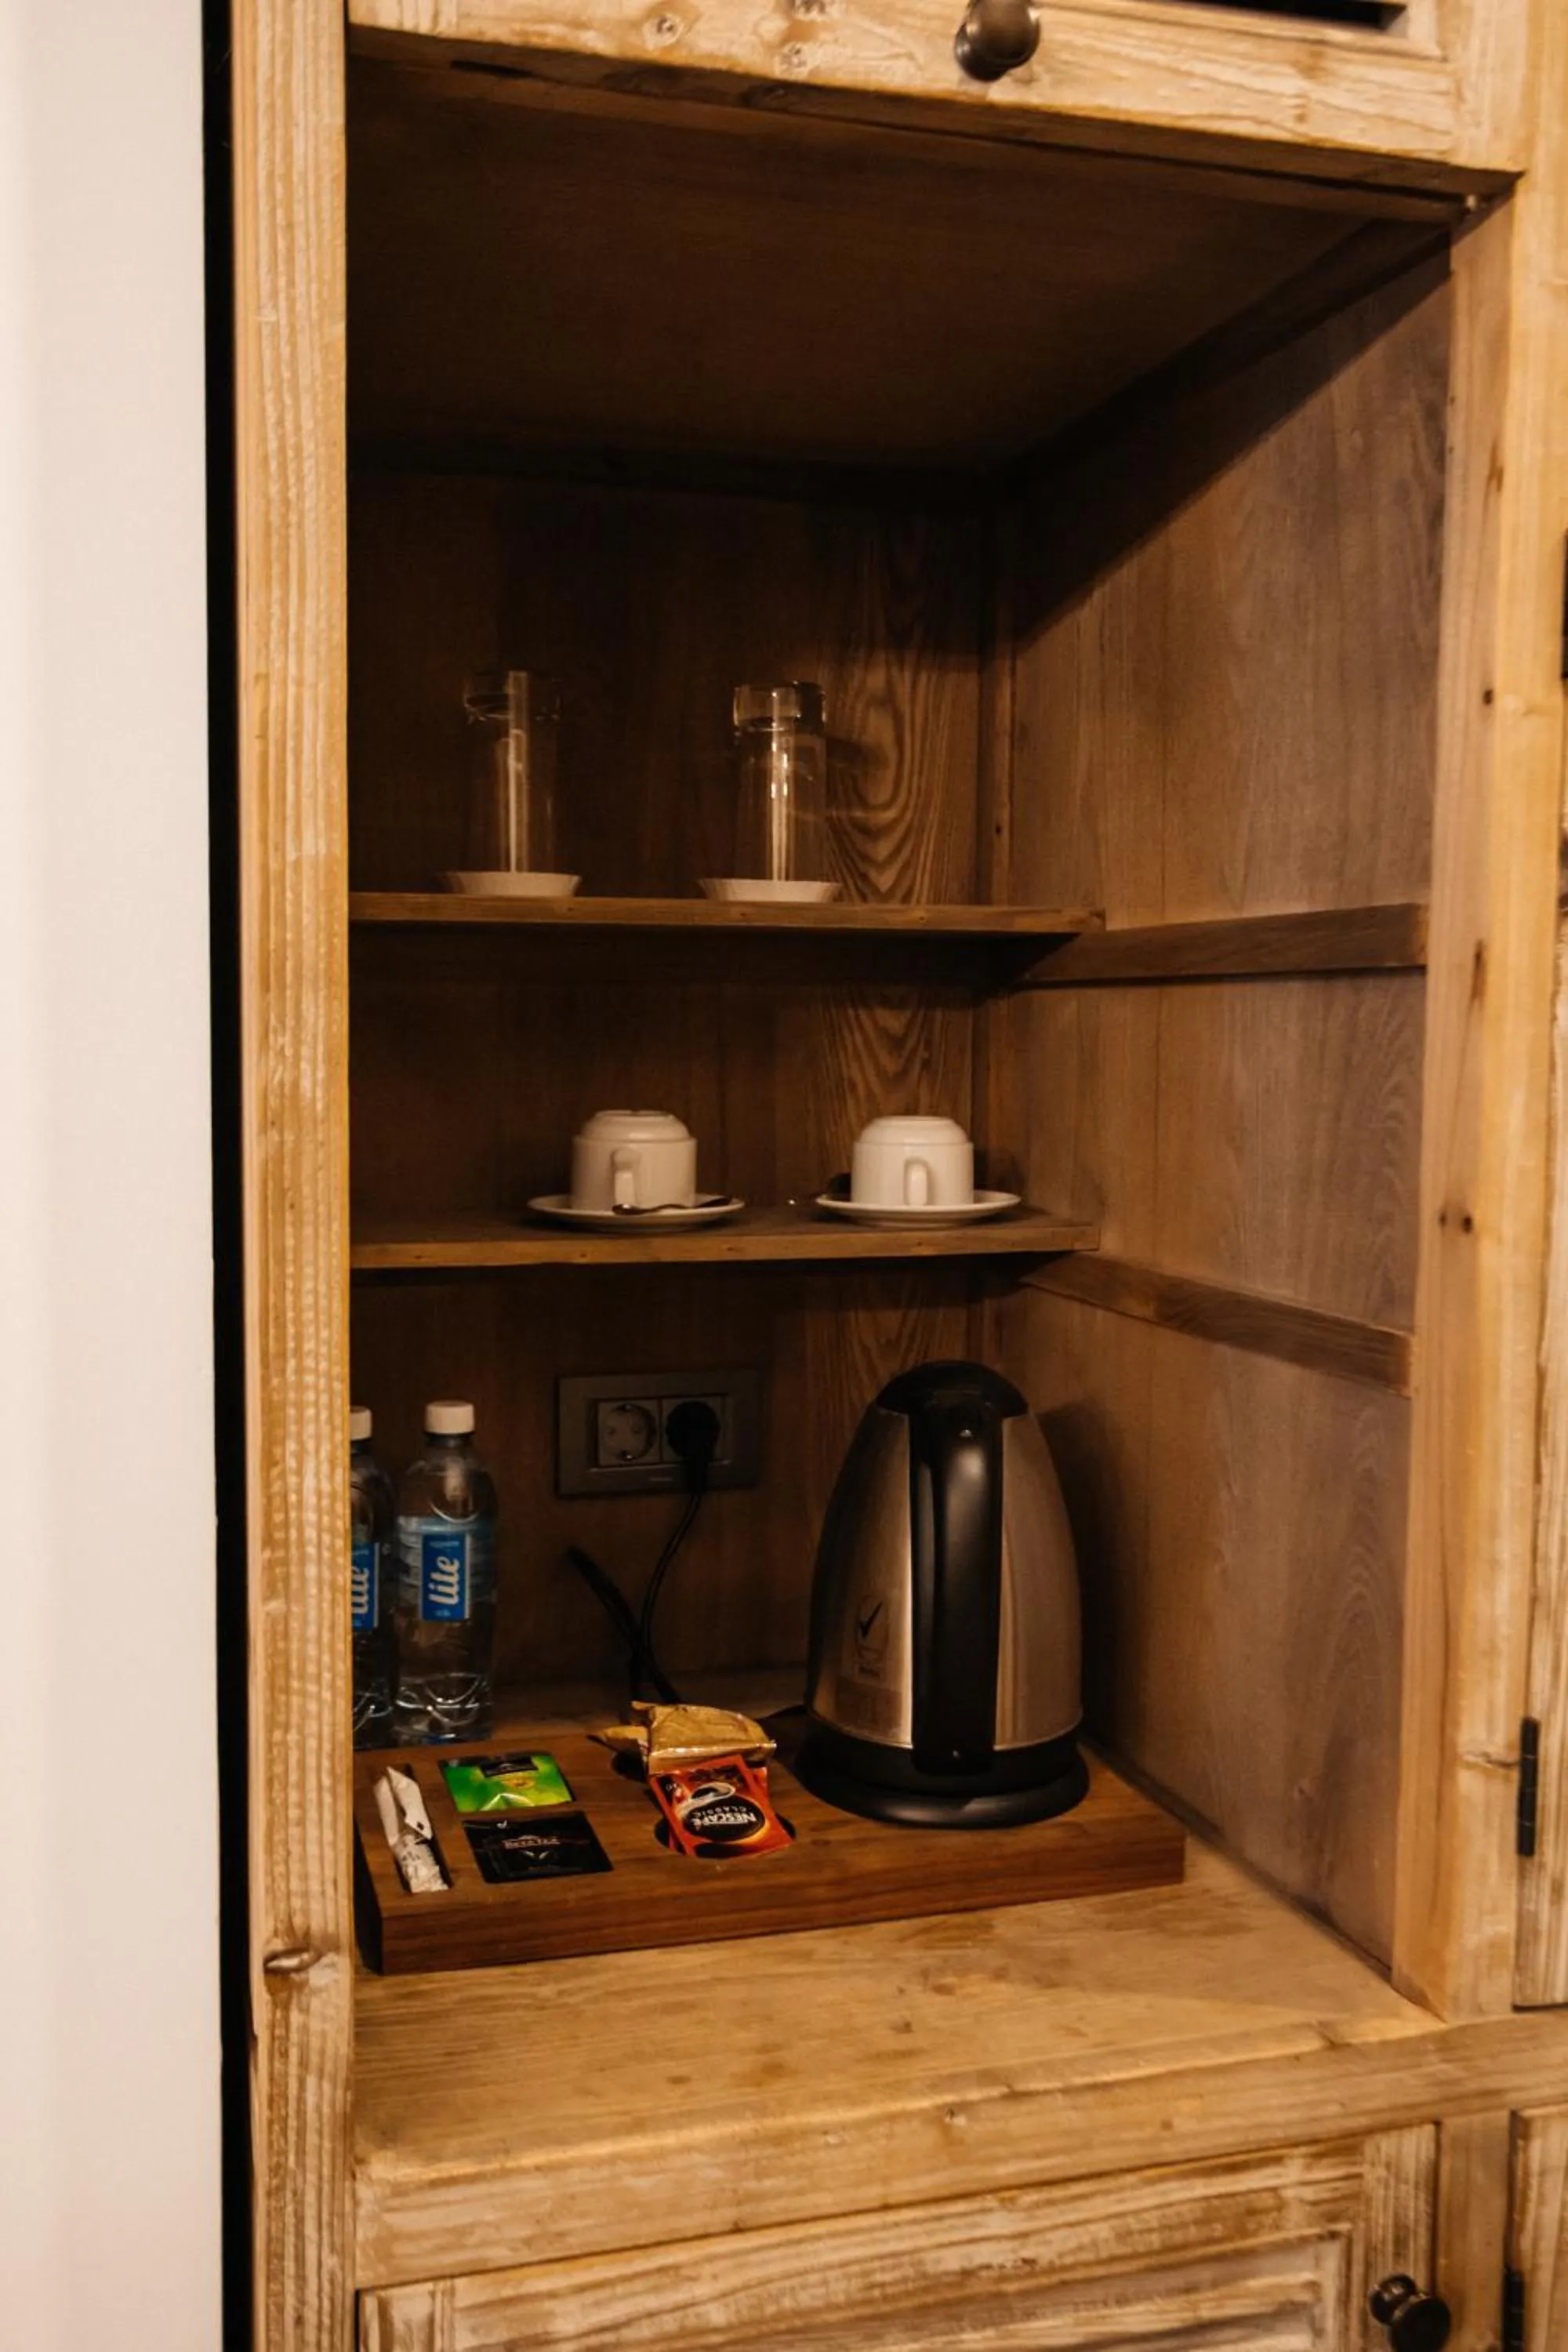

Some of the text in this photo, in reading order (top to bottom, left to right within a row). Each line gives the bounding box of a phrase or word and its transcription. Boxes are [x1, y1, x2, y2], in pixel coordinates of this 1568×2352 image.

[428, 1556, 460, 1605] lite
[692, 1806, 747, 1819] CLASSIC
[692, 1812, 757, 1830] NESCAFÉ
